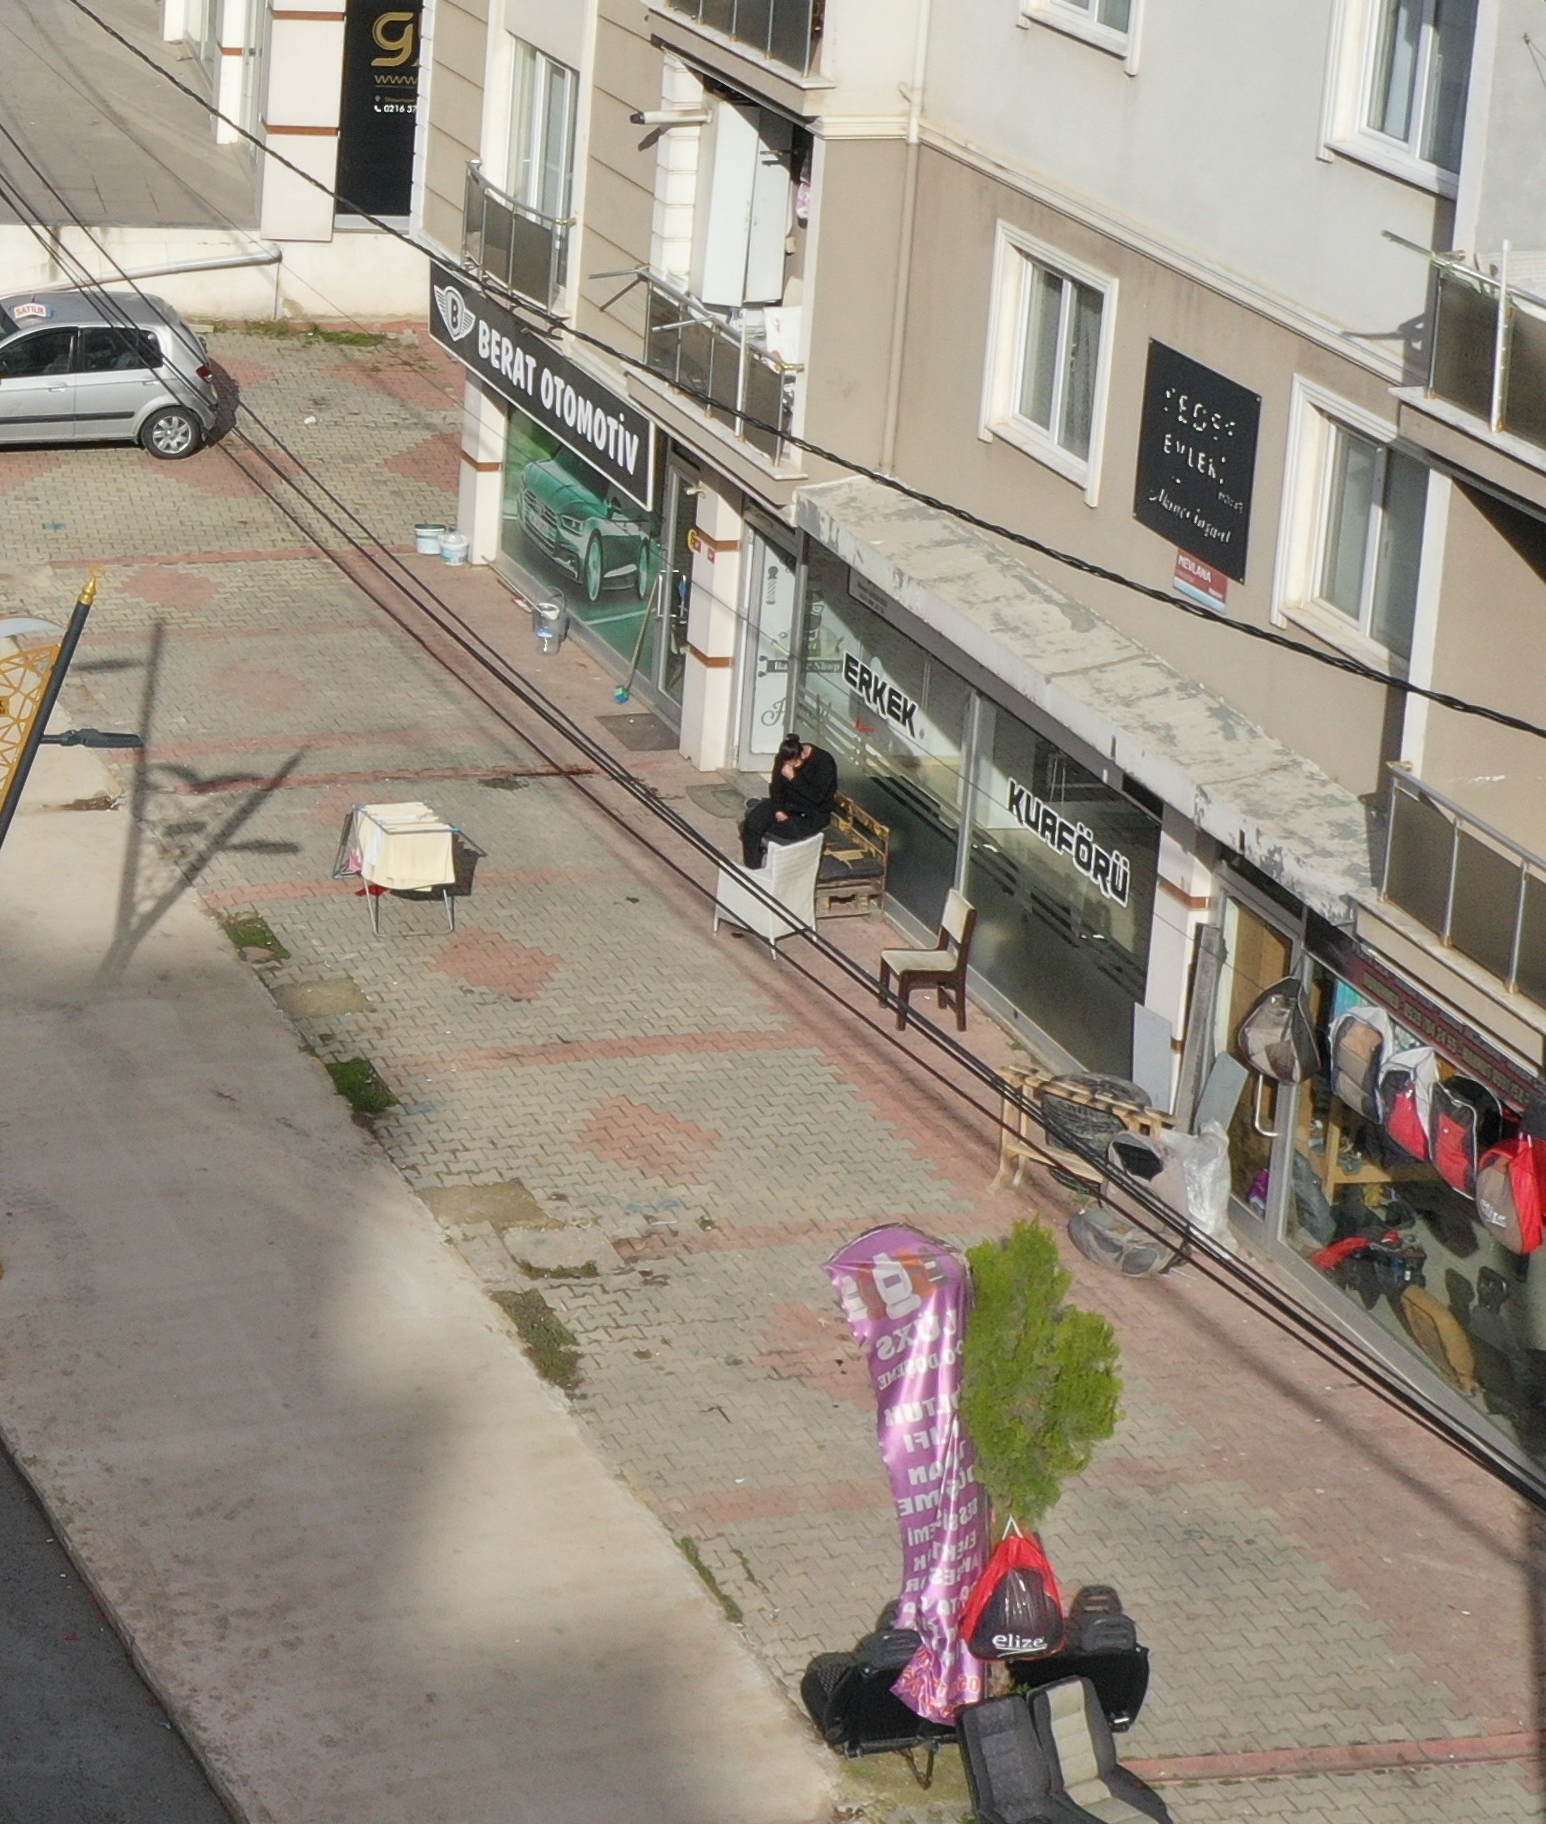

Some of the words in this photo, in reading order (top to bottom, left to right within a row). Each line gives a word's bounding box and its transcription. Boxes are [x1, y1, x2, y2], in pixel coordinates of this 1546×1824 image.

[383, 105, 405, 114] 0216
[477, 319, 537, 396] BERAT
[540, 367, 640, 476] OTOMOTİV
[842, 650, 919, 738] ERKEK
[1008, 777, 1130, 908] KUAFÖRÜ
[992, 1634, 1045, 1648] elize
